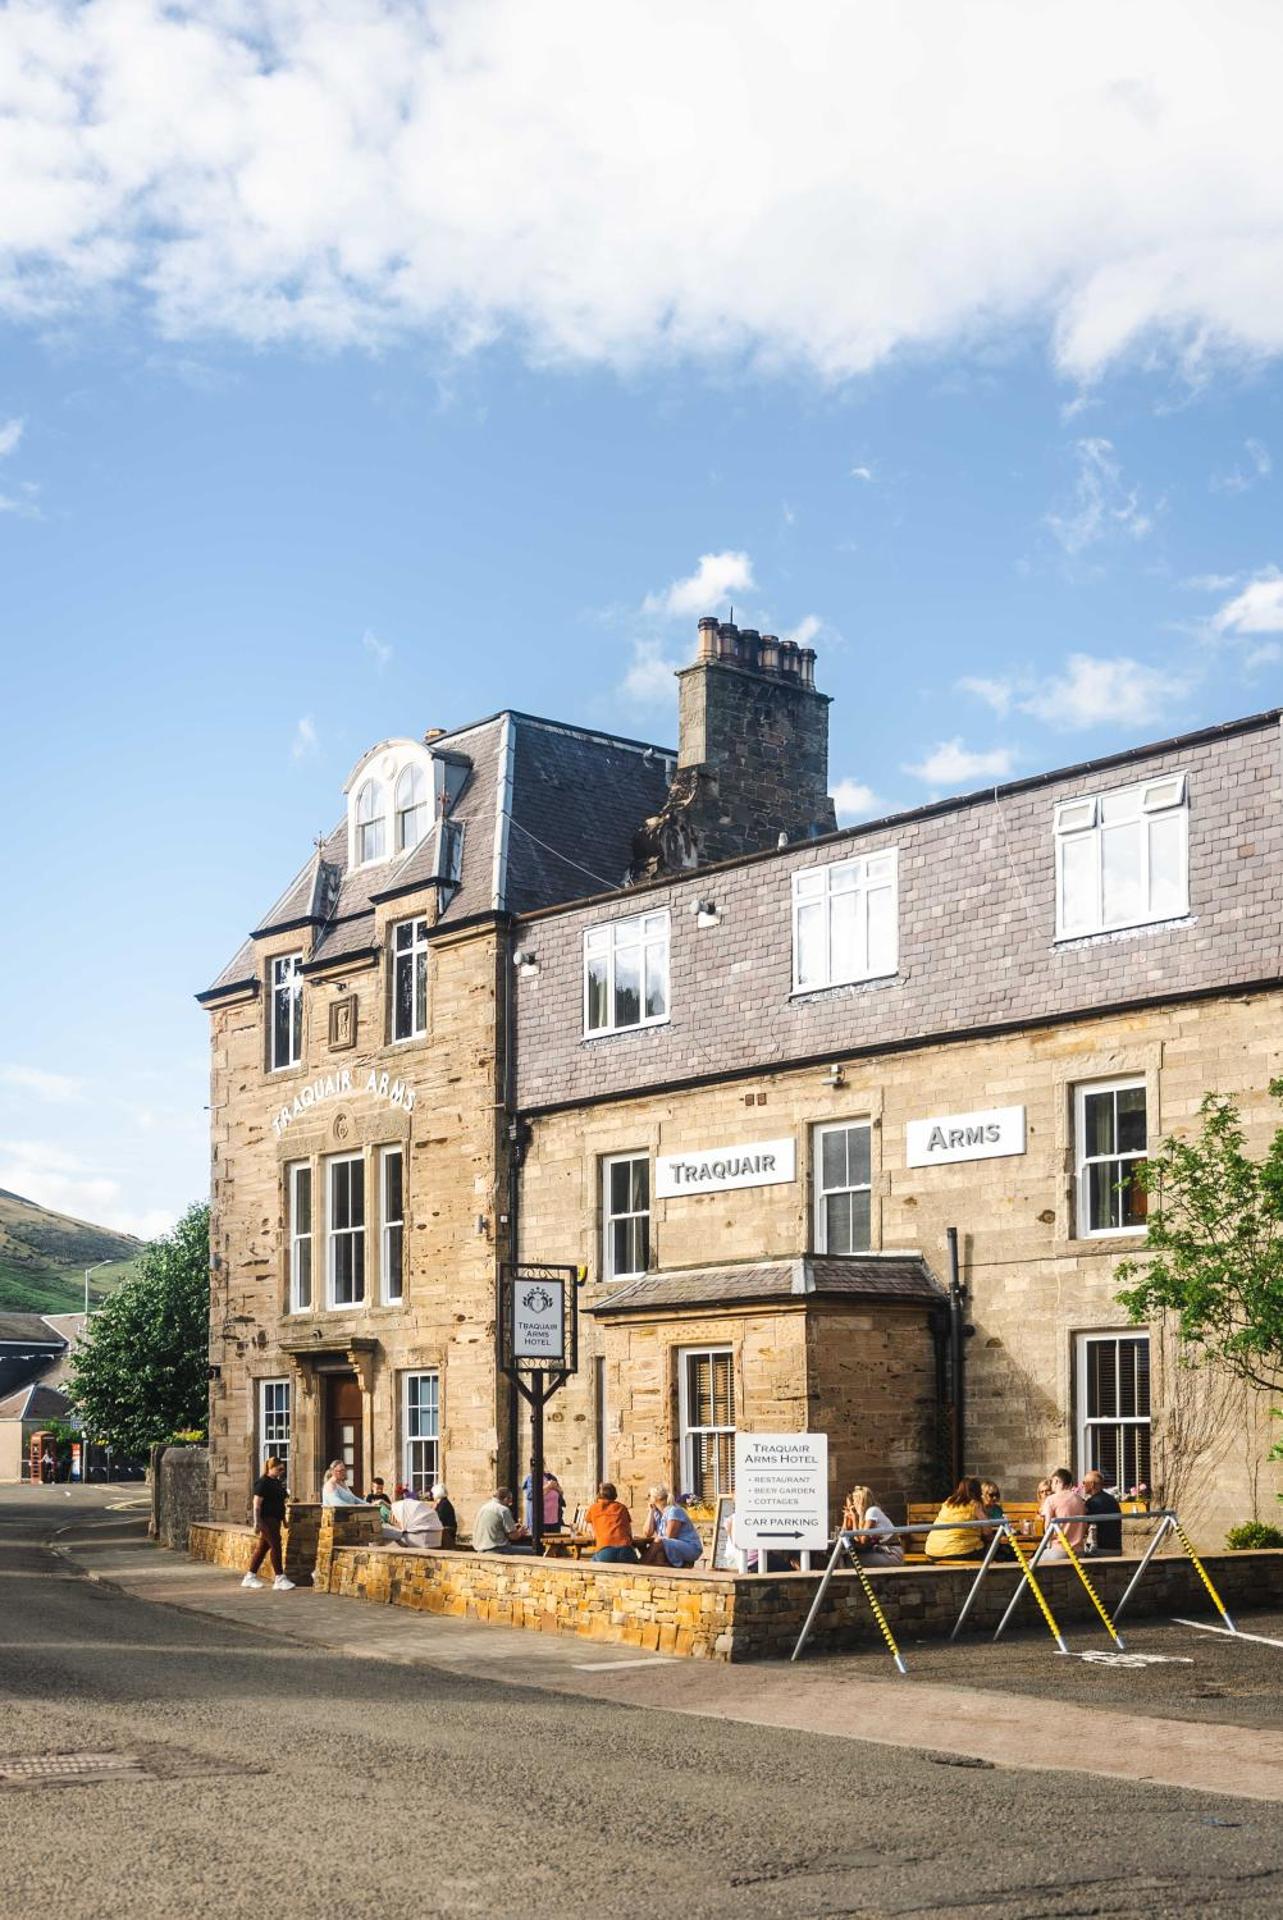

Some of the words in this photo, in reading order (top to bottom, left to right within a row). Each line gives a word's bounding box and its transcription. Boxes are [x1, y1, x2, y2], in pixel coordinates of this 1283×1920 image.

[272, 1069, 353, 1136] TRAQUAIR
[366, 1069, 416, 1112] ARMS
[927, 1123, 1001, 1152] ARMS
[669, 1154, 777, 1185] TRAQUAIR
[517, 1321, 558, 1330] TRAQUAIR
[526, 1330, 550, 1338] ARMS
[524, 1338, 552, 1346] HOTEL
[753, 1443, 811, 1453] TRAQUAIR
[744, 1454, 778, 1464] ARMS
[780, 1454, 819, 1464] HOTEL
[754, 1476, 811, 1484] RESTAURANT
[754, 1487, 778, 1495] BEER
[779, 1487, 816, 1495] GARDEN
[754, 1498, 799, 1506] COTTAGES
[744, 1517, 768, 1527] CAR
[770, 1517, 819, 1527] PARKING
